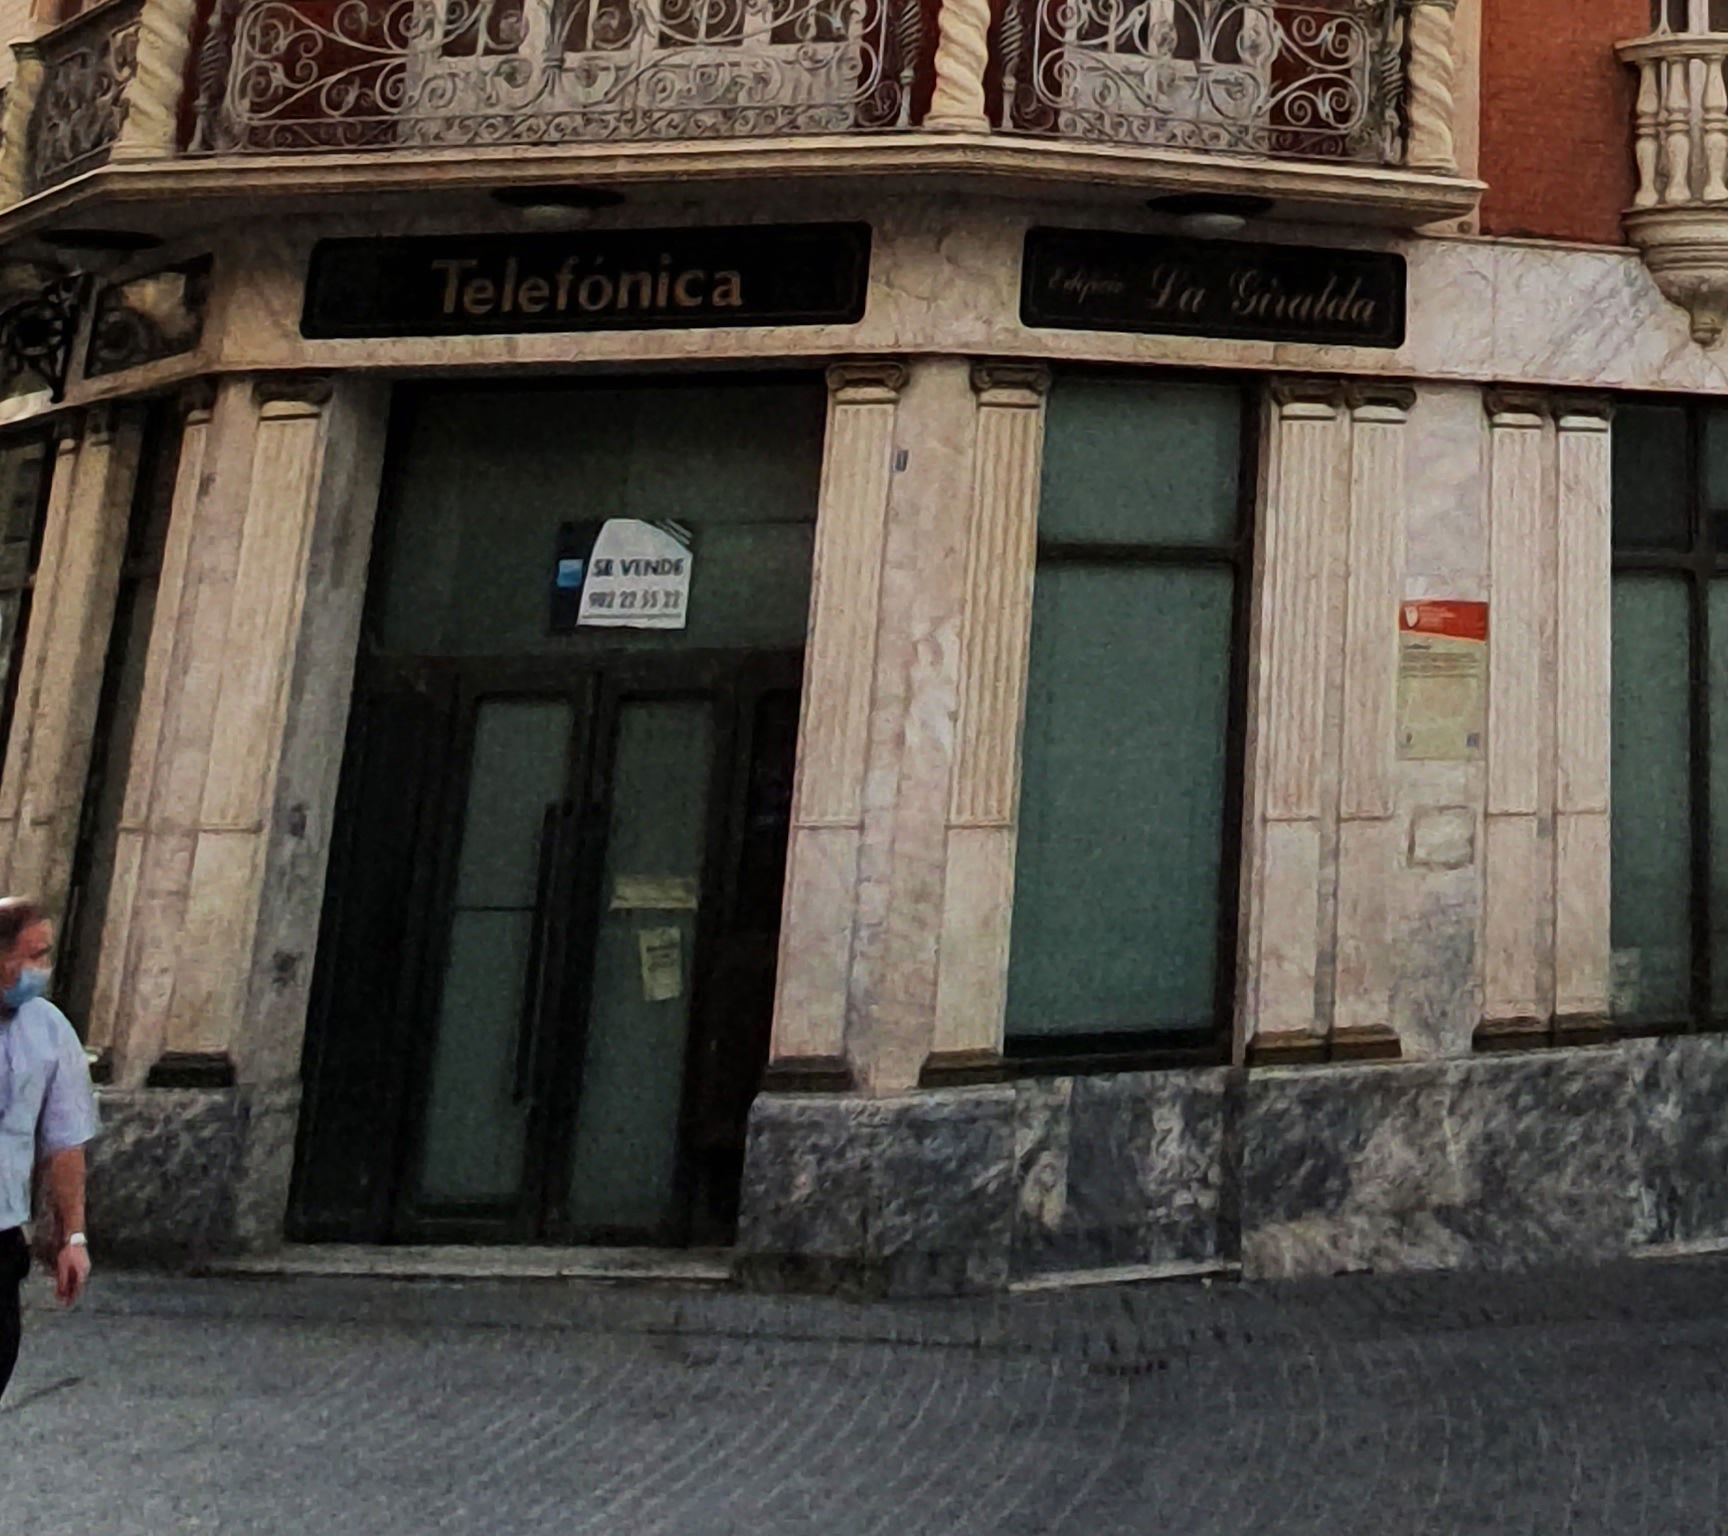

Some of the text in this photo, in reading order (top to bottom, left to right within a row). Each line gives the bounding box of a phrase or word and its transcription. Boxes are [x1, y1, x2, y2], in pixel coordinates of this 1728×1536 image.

[431, 252, 744, 315] Telefónica
[1148, 263, 1207, 314] La
[1229, 269, 1378, 324] Giralda
[592, 557, 684, 577] SE VENDE
